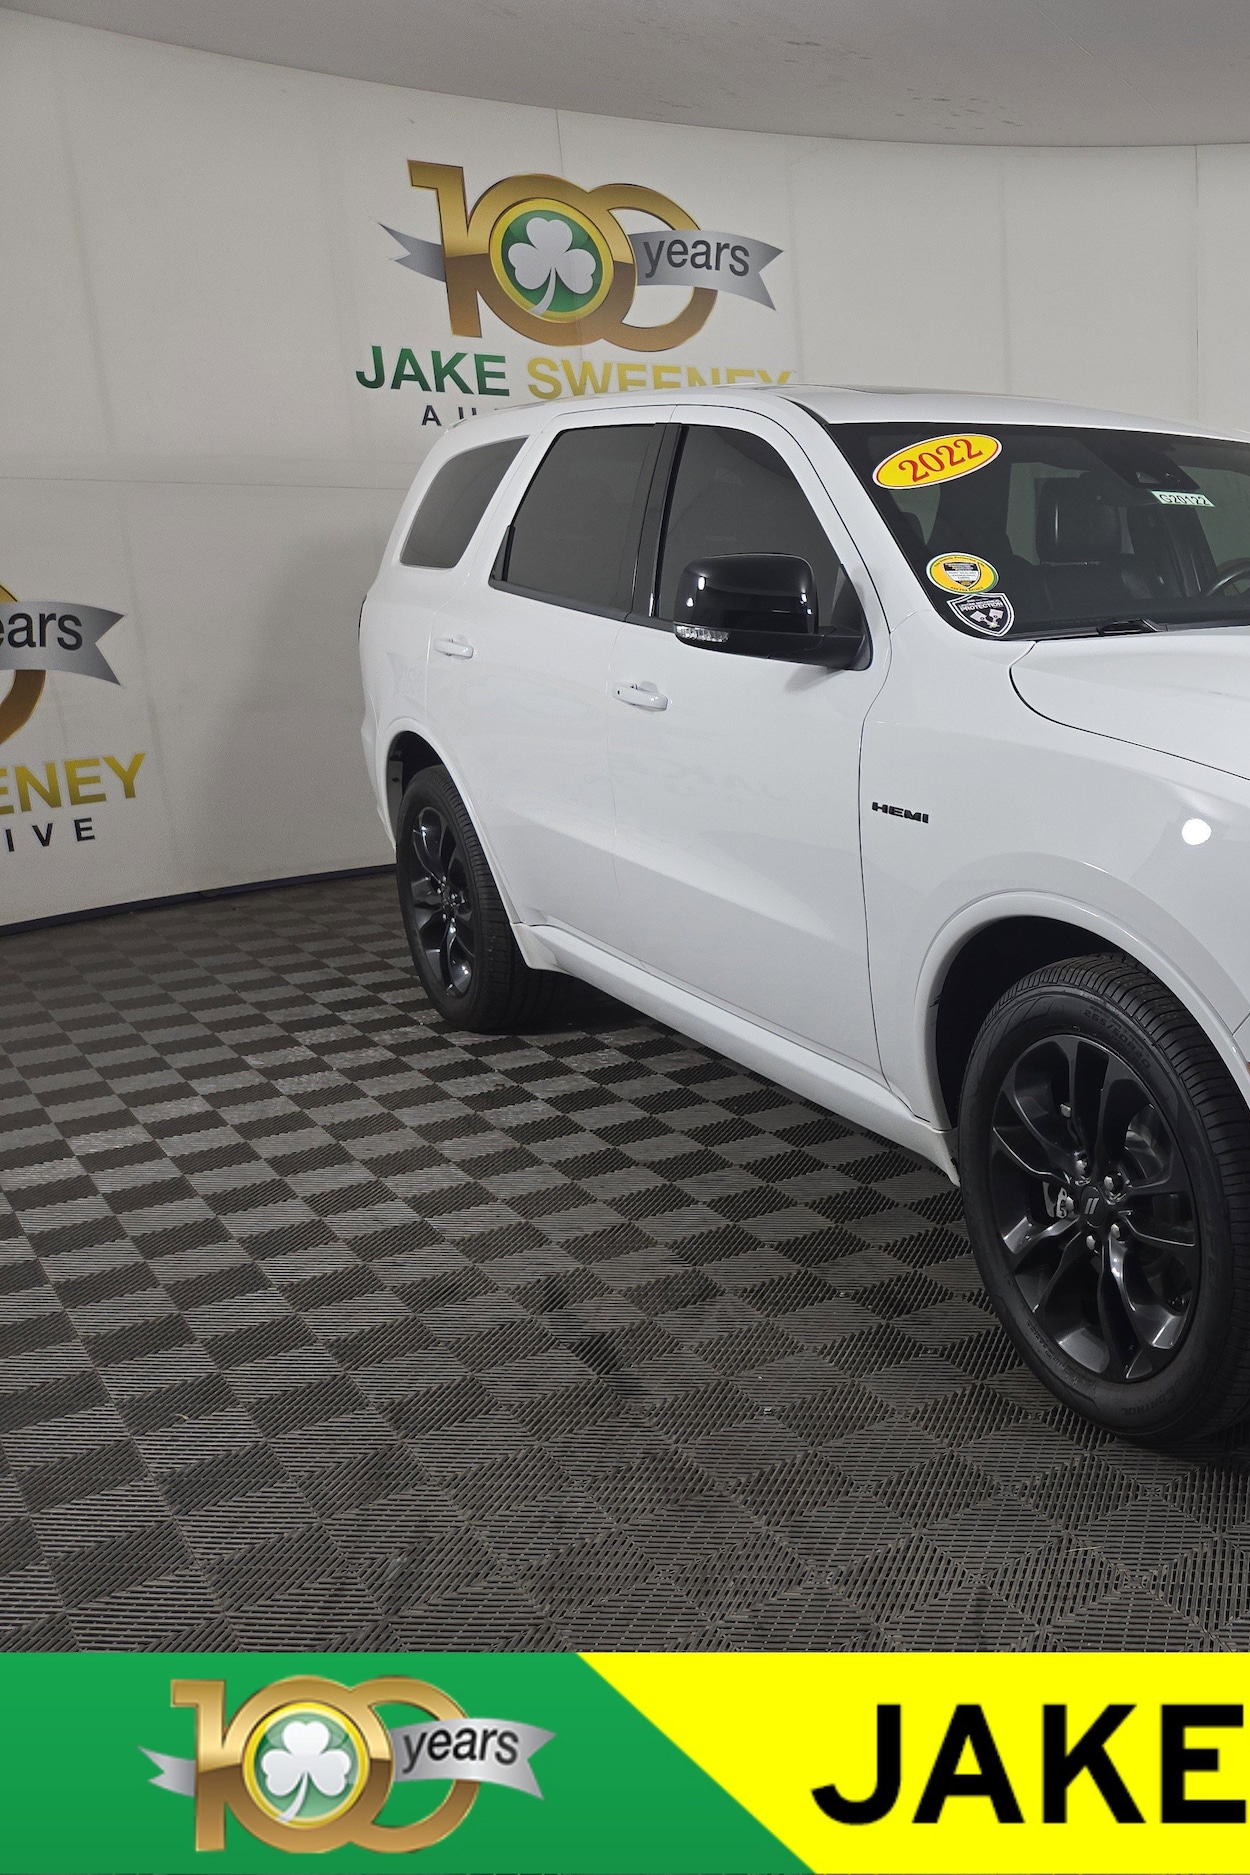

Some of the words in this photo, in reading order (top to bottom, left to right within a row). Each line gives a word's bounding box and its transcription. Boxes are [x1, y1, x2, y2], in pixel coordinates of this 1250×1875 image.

[407, 159, 718, 352] 100
[643, 236, 750, 278] years
[356, 345, 510, 397] JAKE
[898, 438, 983, 483] 2022
[0, 612, 82, 650] ars
[872, 802, 929, 823] HEMI
